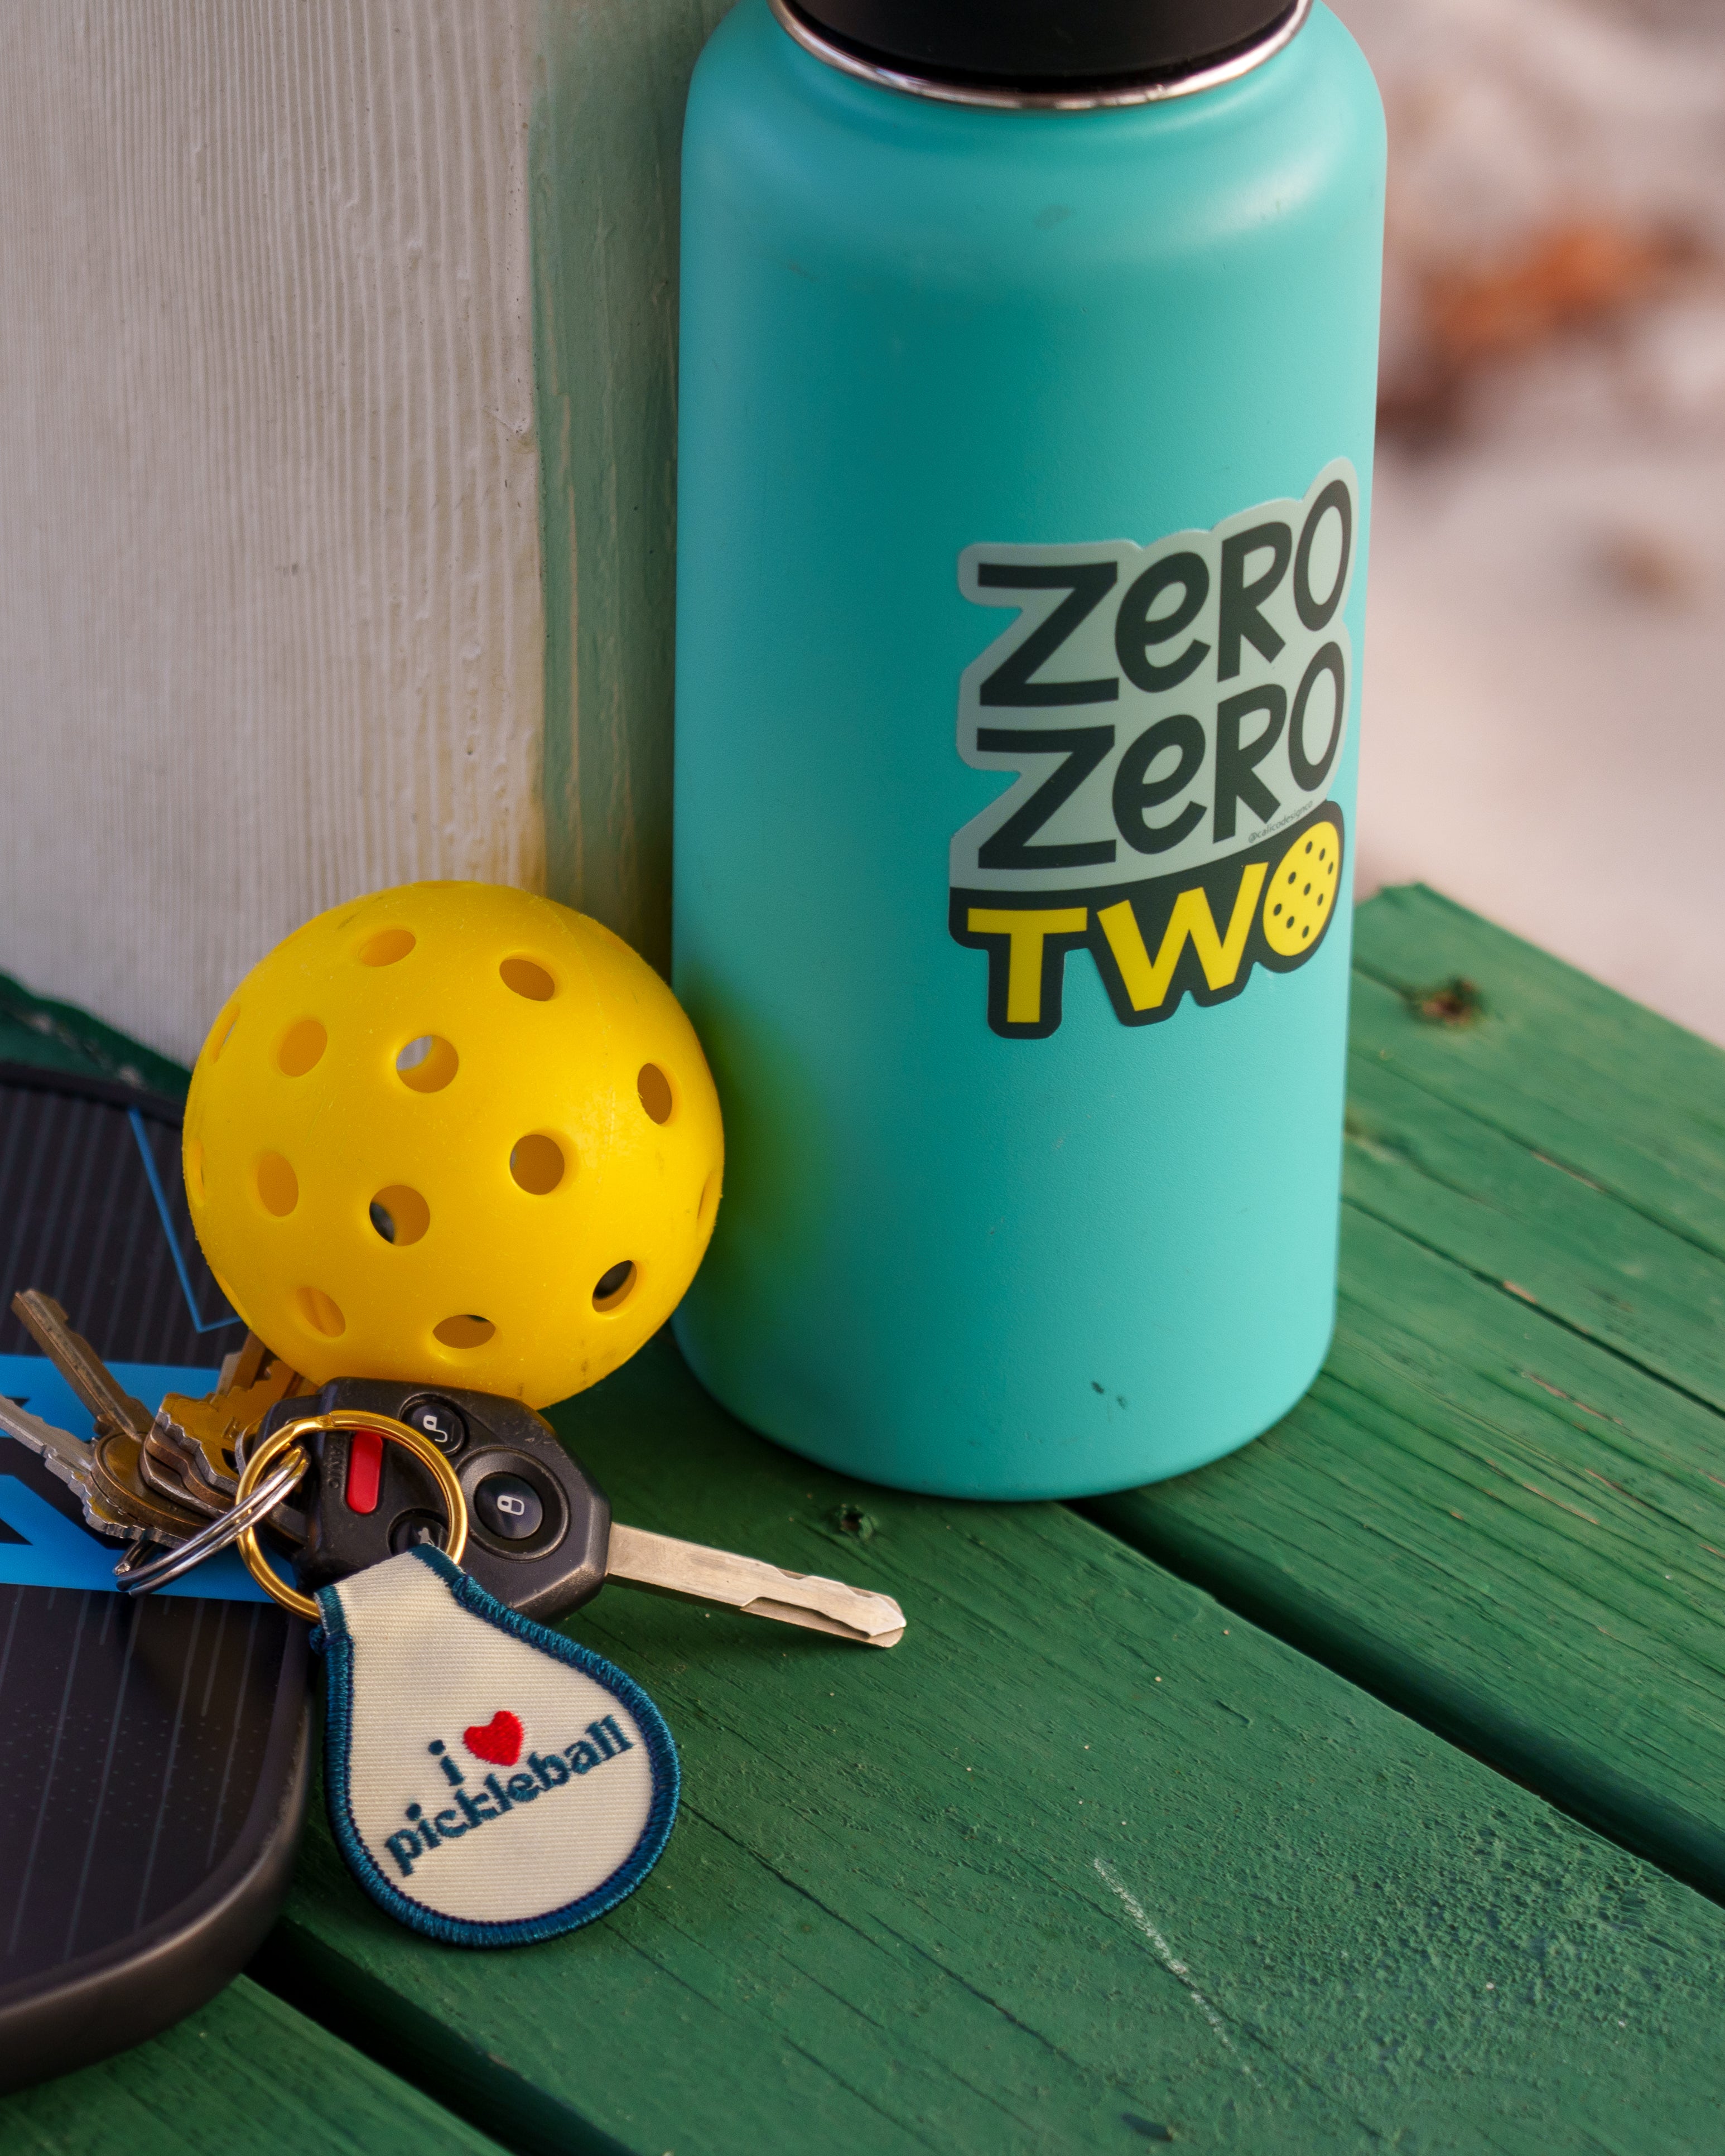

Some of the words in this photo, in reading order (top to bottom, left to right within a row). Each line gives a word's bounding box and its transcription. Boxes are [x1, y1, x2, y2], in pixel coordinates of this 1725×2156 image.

[967, 821, 1340, 1023] TWO
[328, 1436, 344, 1489] PANIC
[384, 1715, 635, 1877] pickleball
[428, 1739, 465, 1787] i
